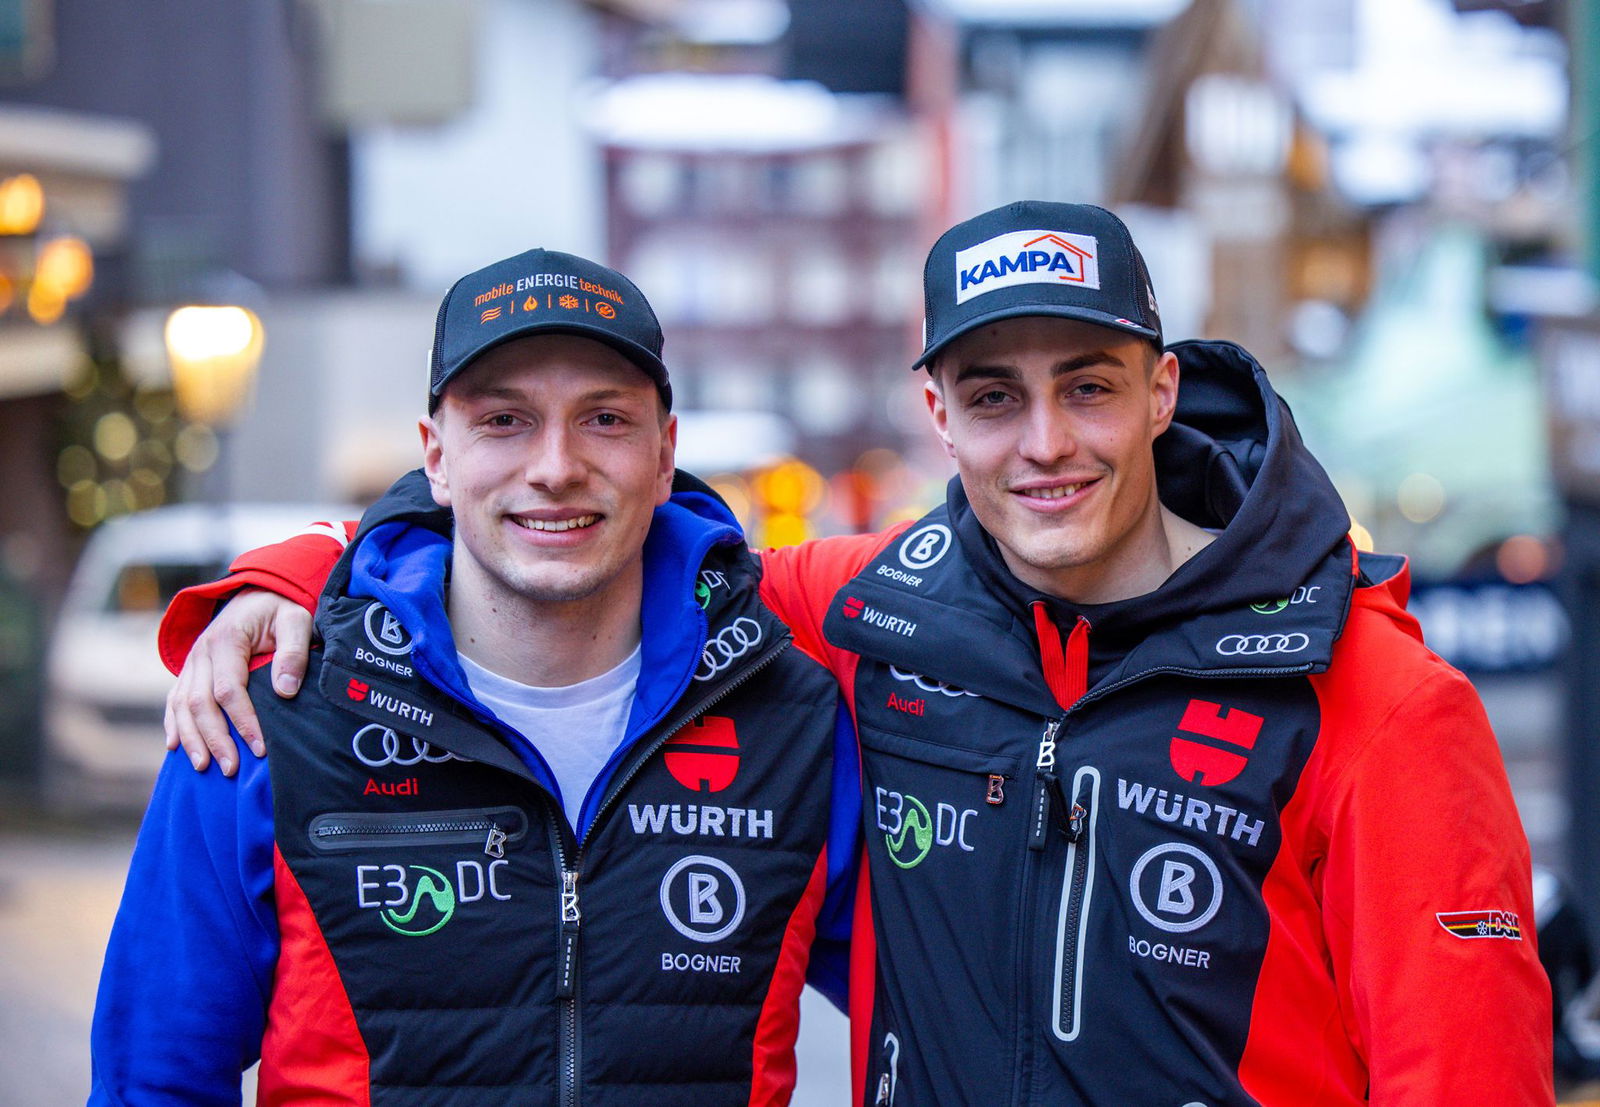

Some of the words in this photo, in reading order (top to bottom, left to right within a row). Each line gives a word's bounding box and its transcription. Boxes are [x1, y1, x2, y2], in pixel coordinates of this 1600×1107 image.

[960, 250, 1074, 290] KAMPA
[474, 283, 514, 308] mobile
[516, 273, 579, 292] ENERGIE
[579, 277, 625, 306] technik
[876, 564, 923, 588] BOGNER
[354, 647, 413, 678] BOGNER
[886, 692, 926, 717] Audi
[363, 777, 419, 796] Audi
[628, 803, 774, 839] WÜRTH
[1117, 778, 1265, 847] WÜRTH
[661, 952, 741, 974] BOGNER
[1128, 935, 1211, 970] BOGNER
